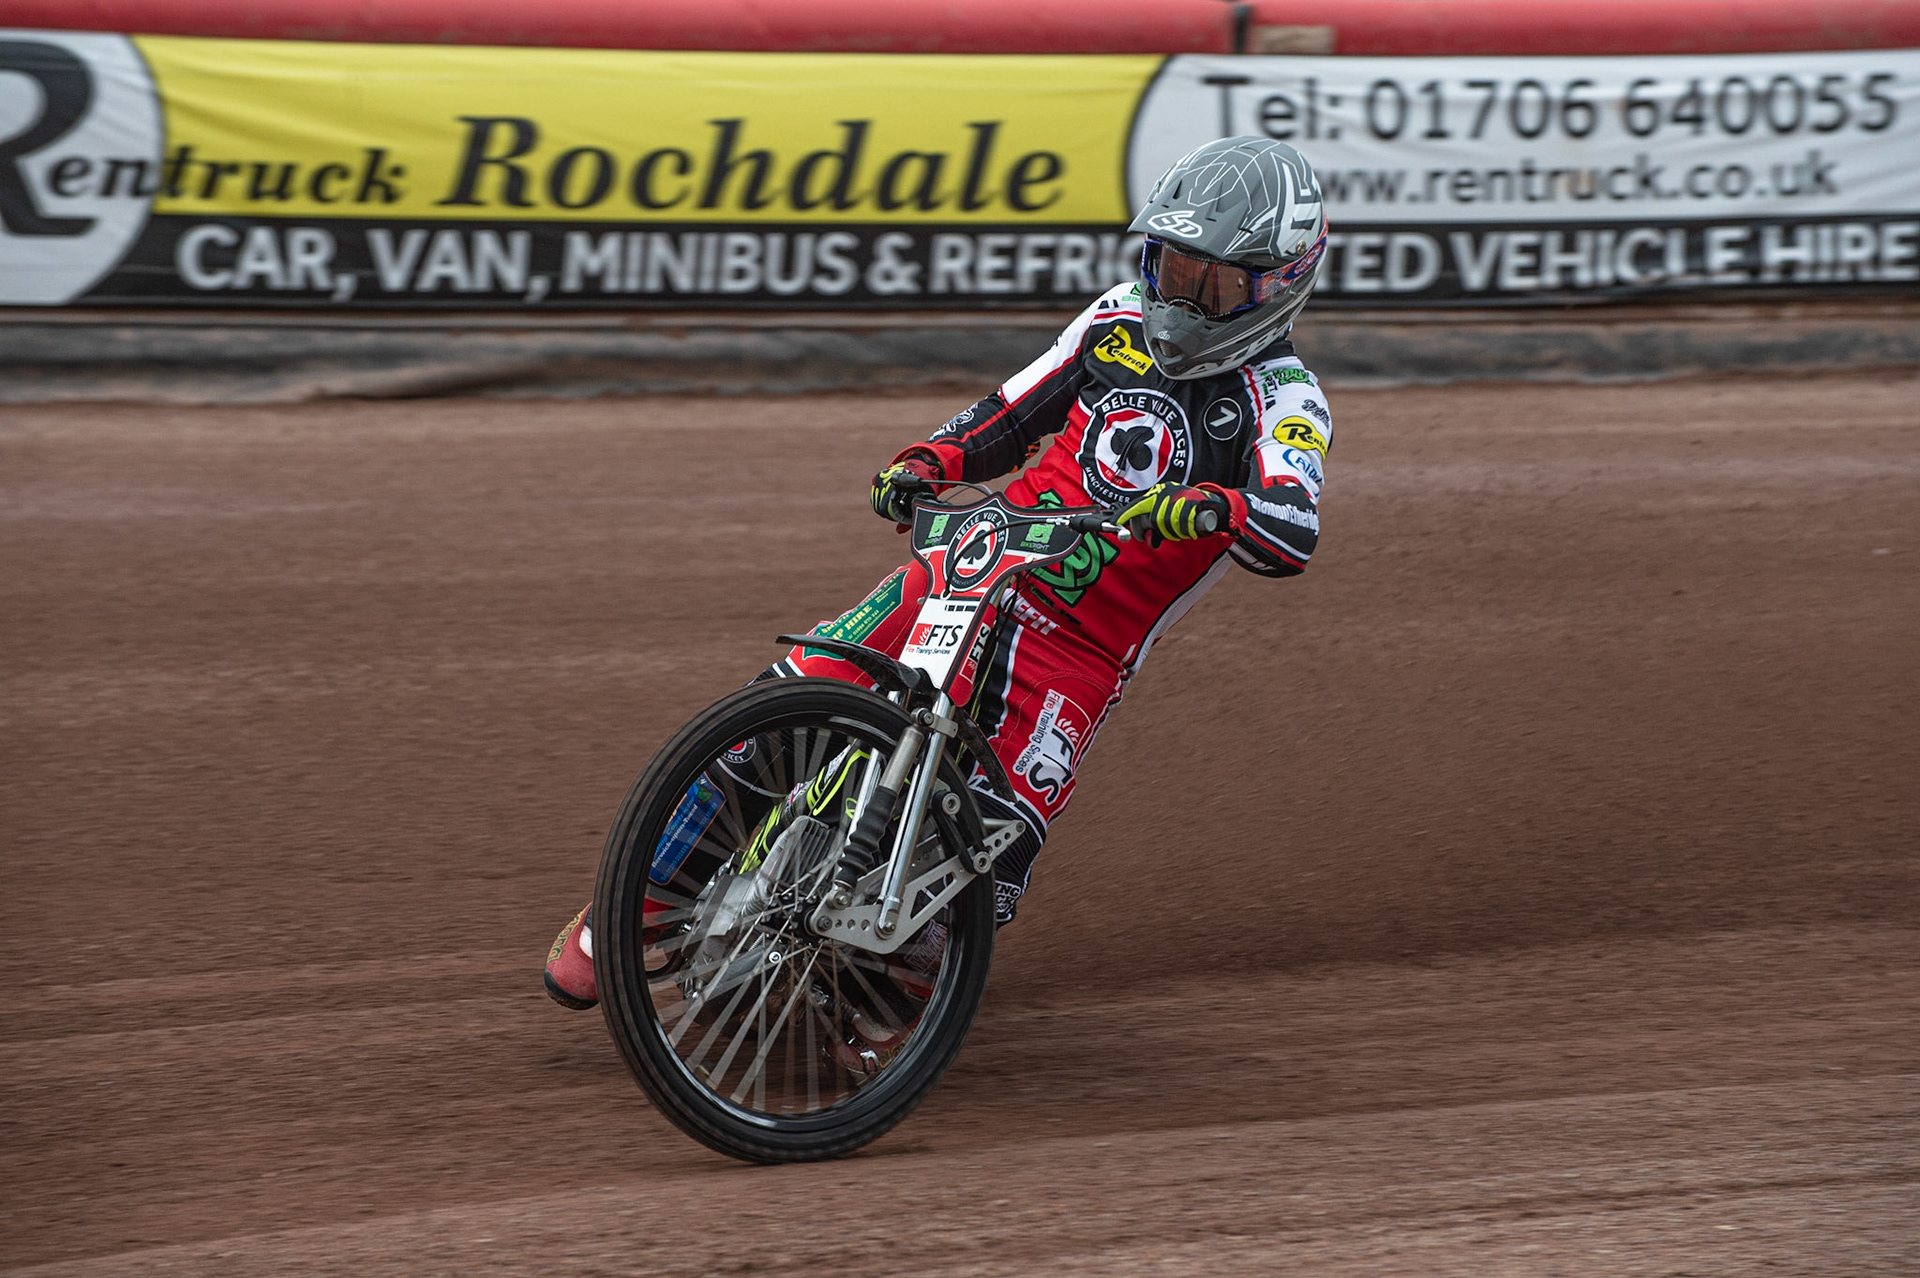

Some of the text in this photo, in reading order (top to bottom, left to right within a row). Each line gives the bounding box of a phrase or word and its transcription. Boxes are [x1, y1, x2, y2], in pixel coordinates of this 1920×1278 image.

[1201, 73, 1898, 141] Tel: 01706 640055
[432, 116, 1065, 212] Rochdale
[1314, 150, 1838, 205] ww.rentruck.co.uk
[174, 225, 359, 302] CAR,
[366, 228, 551, 303] VAN,
[562, 231, 860, 294] MINIBUS
[865, 232, 921, 294] &
[1448, 226, 1750, 292] VEHICLE
[1759, 222, 1919, 281] HIRE
[1098, 332, 1147, 370] Rentruck
[1101, 394, 1186, 468] BELLE VUE ACES
[956, 511, 1006, 543] BELLE VUE AES
[844, 605, 873, 630] HIRE
[925, 624, 963, 647] FTS
[1046, 692, 1060, 710] Fire
[1031, 711, 1054, 744] Training
[1028, 727, 1075, 804] FTS
